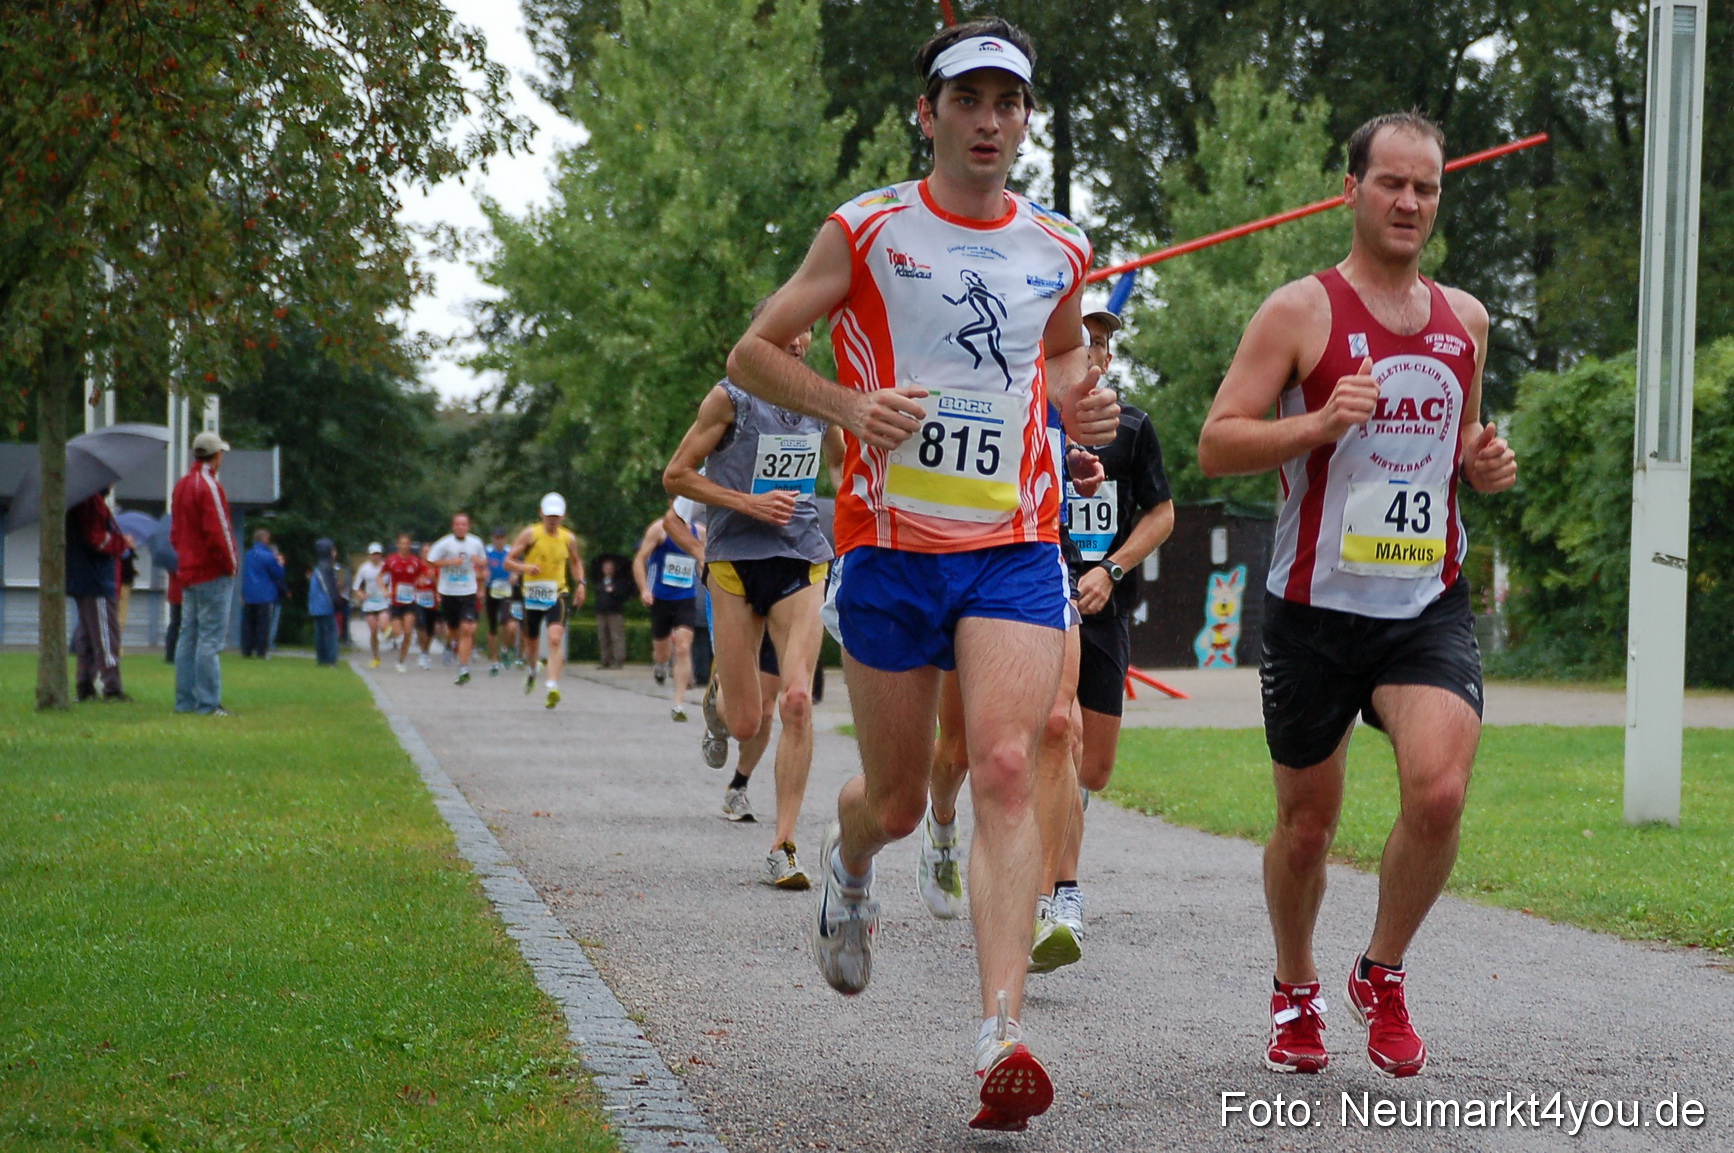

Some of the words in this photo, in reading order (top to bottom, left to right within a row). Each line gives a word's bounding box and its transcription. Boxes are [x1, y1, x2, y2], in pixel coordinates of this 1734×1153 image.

[886, 247, 916, 268] Tom's
[939, 396, 993, 415] BOCK
[1371, 397, 1445, 422] LAC
[1375, 423, 1435, 435] Harlekin
[918, 421, 1002, 476] 815
[762, 452, 816, 478] 3277
[1369, 452, 1433, 473] MISTELBACH
[1384, 490, 1431, 534] 43
[1375, 542, 1434, 562] MArkus
